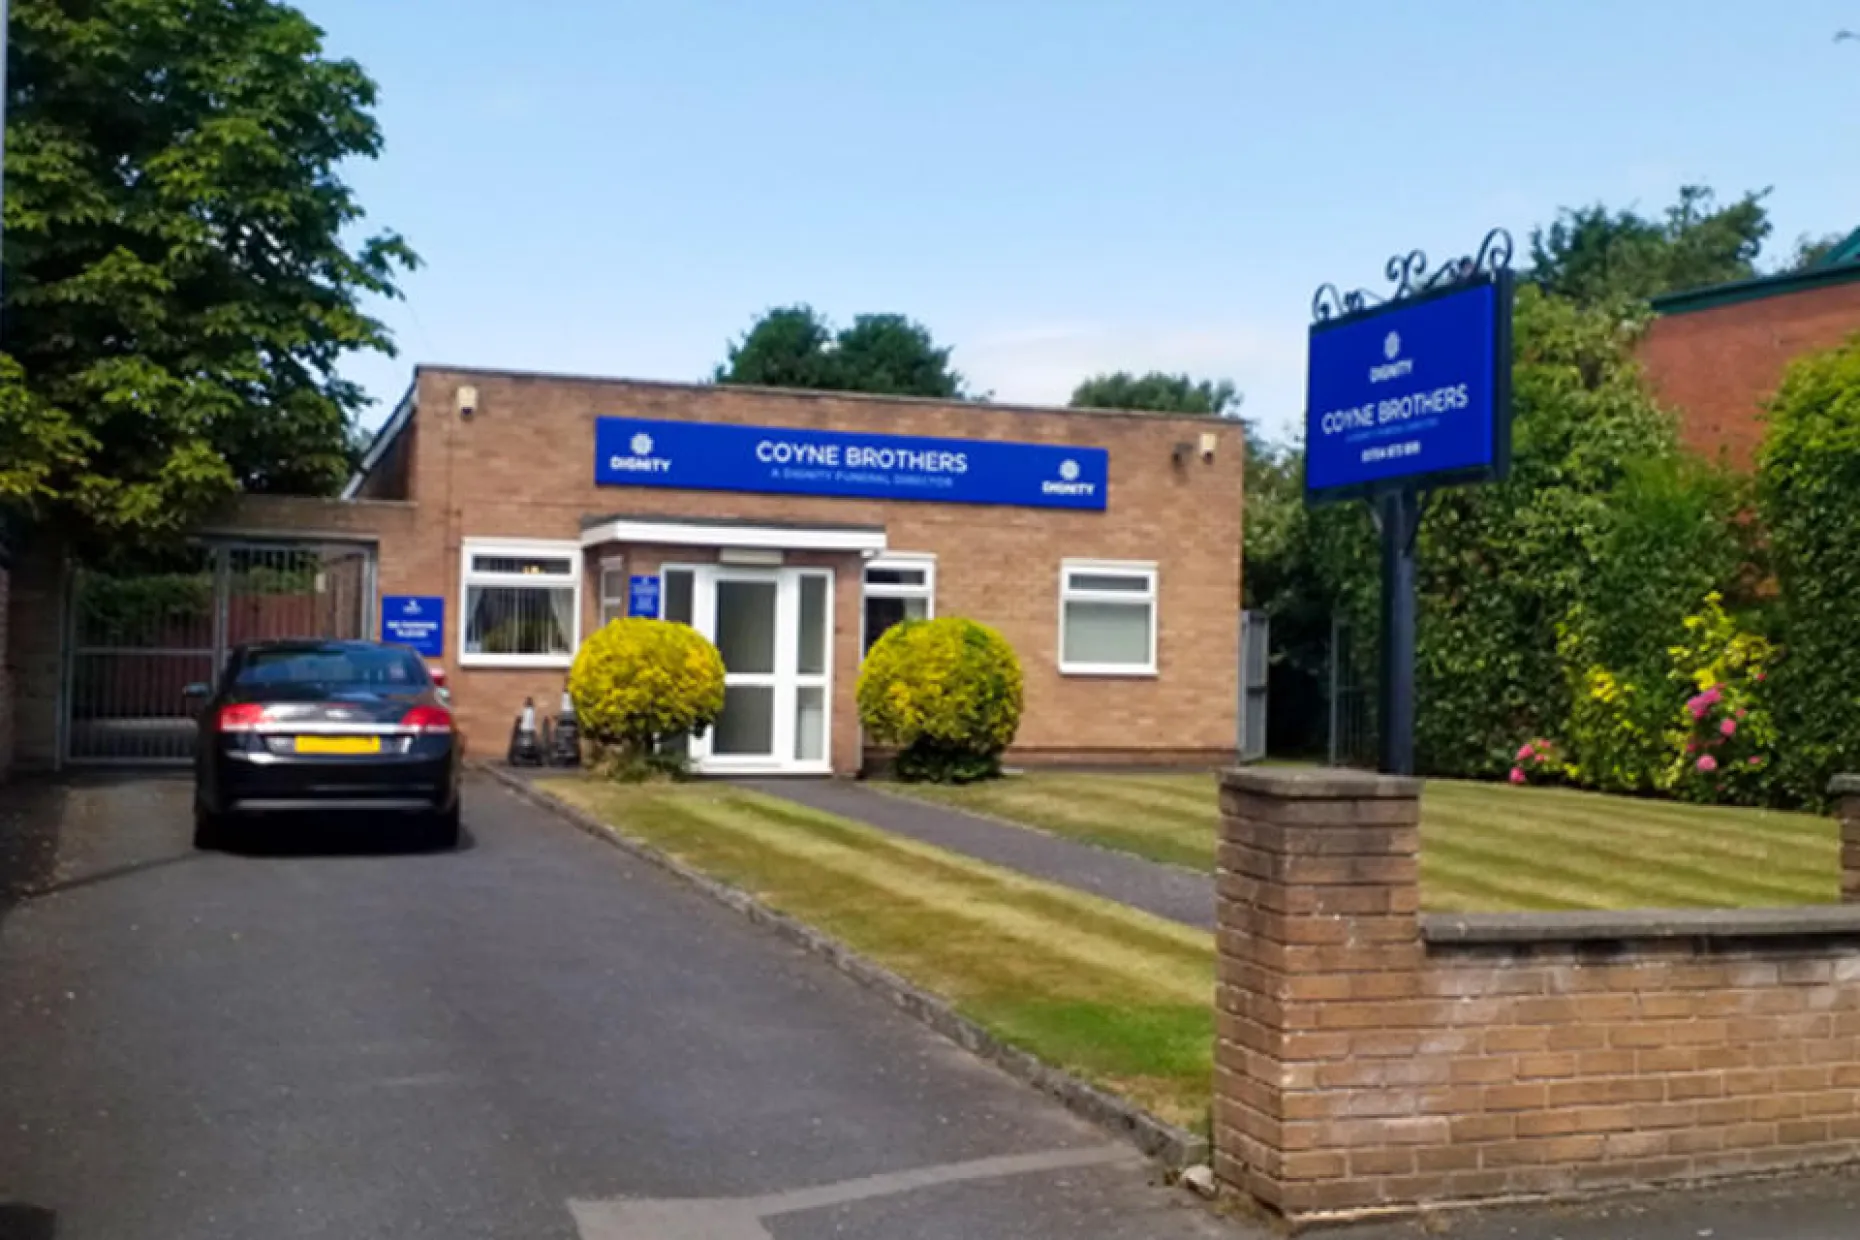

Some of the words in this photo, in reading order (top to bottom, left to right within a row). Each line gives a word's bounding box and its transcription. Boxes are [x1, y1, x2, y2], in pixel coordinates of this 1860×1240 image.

[1321, 402, 1375, 435] COYNE
[1377, 383, 1469, 424] BROTHERS
[609, 455, 672, 472] DIGNITY
[756, 440, 839, 465] COYNE
[846, 446, 968, 473] BROTHERS
[1041, 480, 1096, 496] DIGNITY
